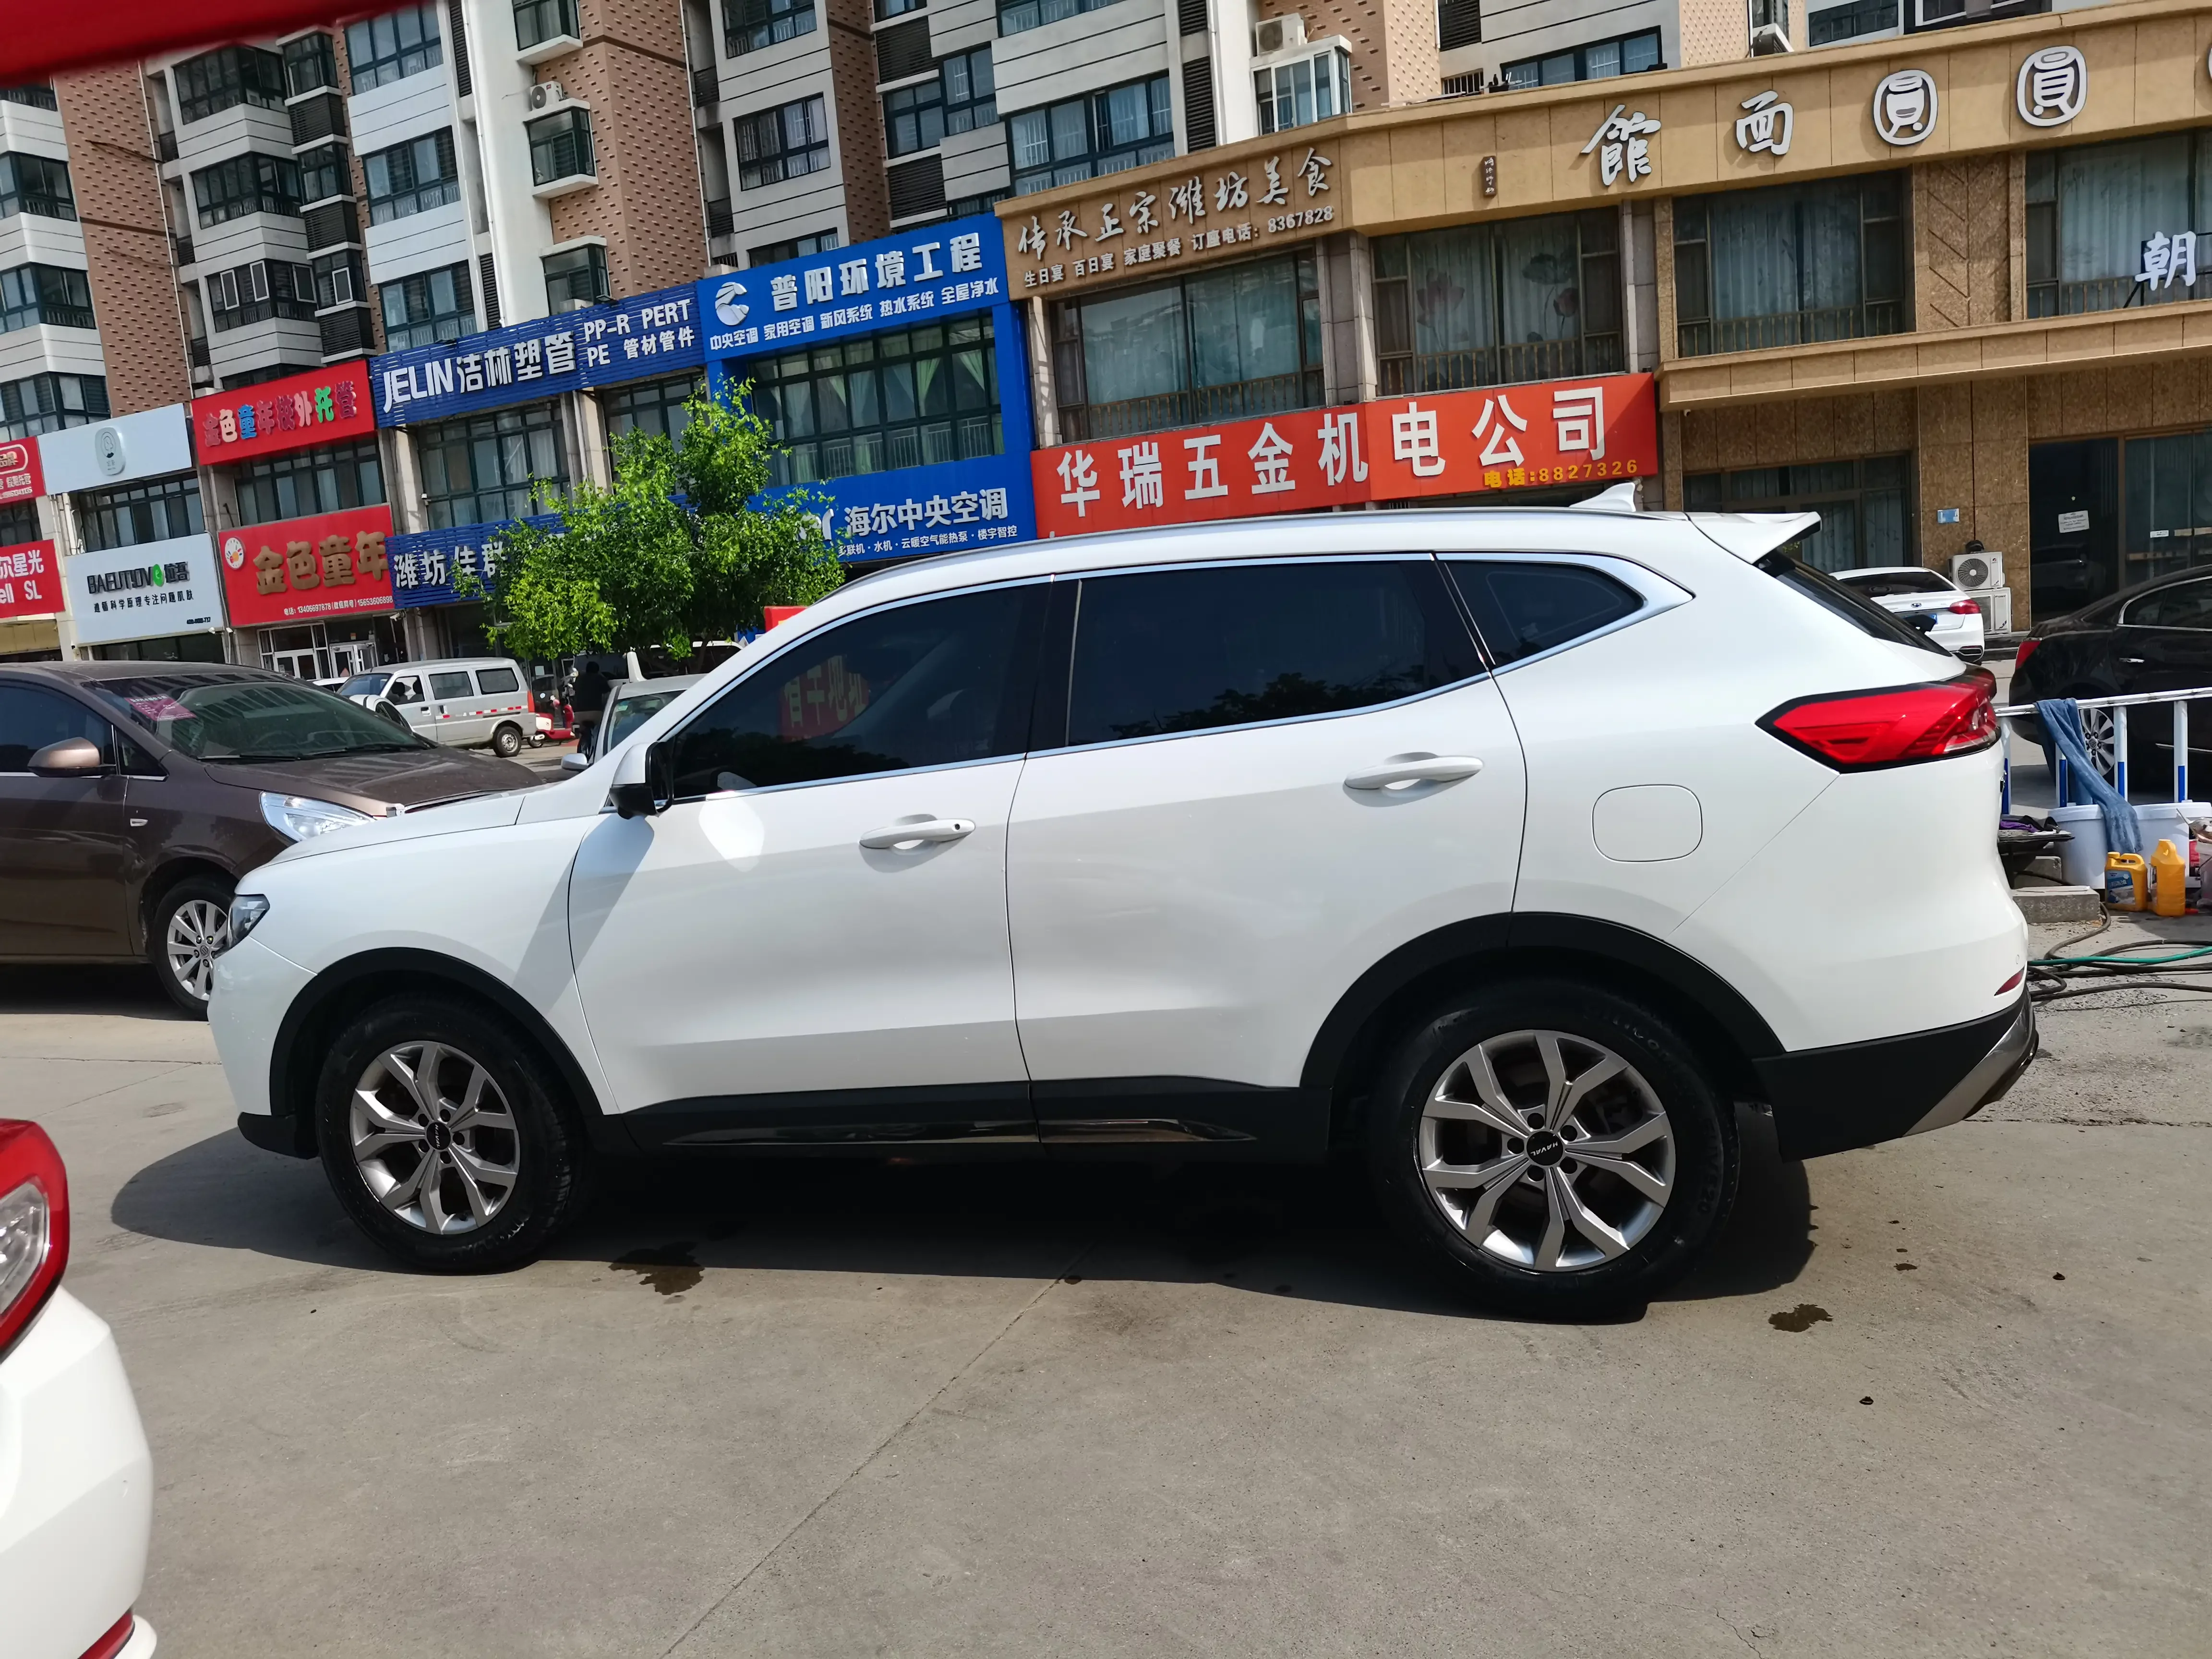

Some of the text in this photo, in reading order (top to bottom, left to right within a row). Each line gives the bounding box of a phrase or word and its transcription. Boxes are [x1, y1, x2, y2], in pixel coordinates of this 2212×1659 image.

[1018, 147, 1332, 260] 传承正宗潍坊美食
[770, 232, 983, 312] 普阳环境工程
[1024, 264, 1065, 288] 生日宴
[1073, 253, 1114, 277] 百日宴
[1123, 237, 1181, 266] 家庭聚餐
[584, 299, 690, 342] PP-R PERT
[709, 277, 999, 350] 中央空调 家用空调 新风系统 热水系统 全屋净水
[587, 325, 695, 367] PE 管材管件
[1057, 386, 1606, 517] 华瑞五金机电公司
[844, 487, 1009, 537] 海尔中央空调
[253, 530, 389, 595] 金色童年
[24, 580, 42, 600] SL
[1530, 1141, 1558, 1156] HAVAL
